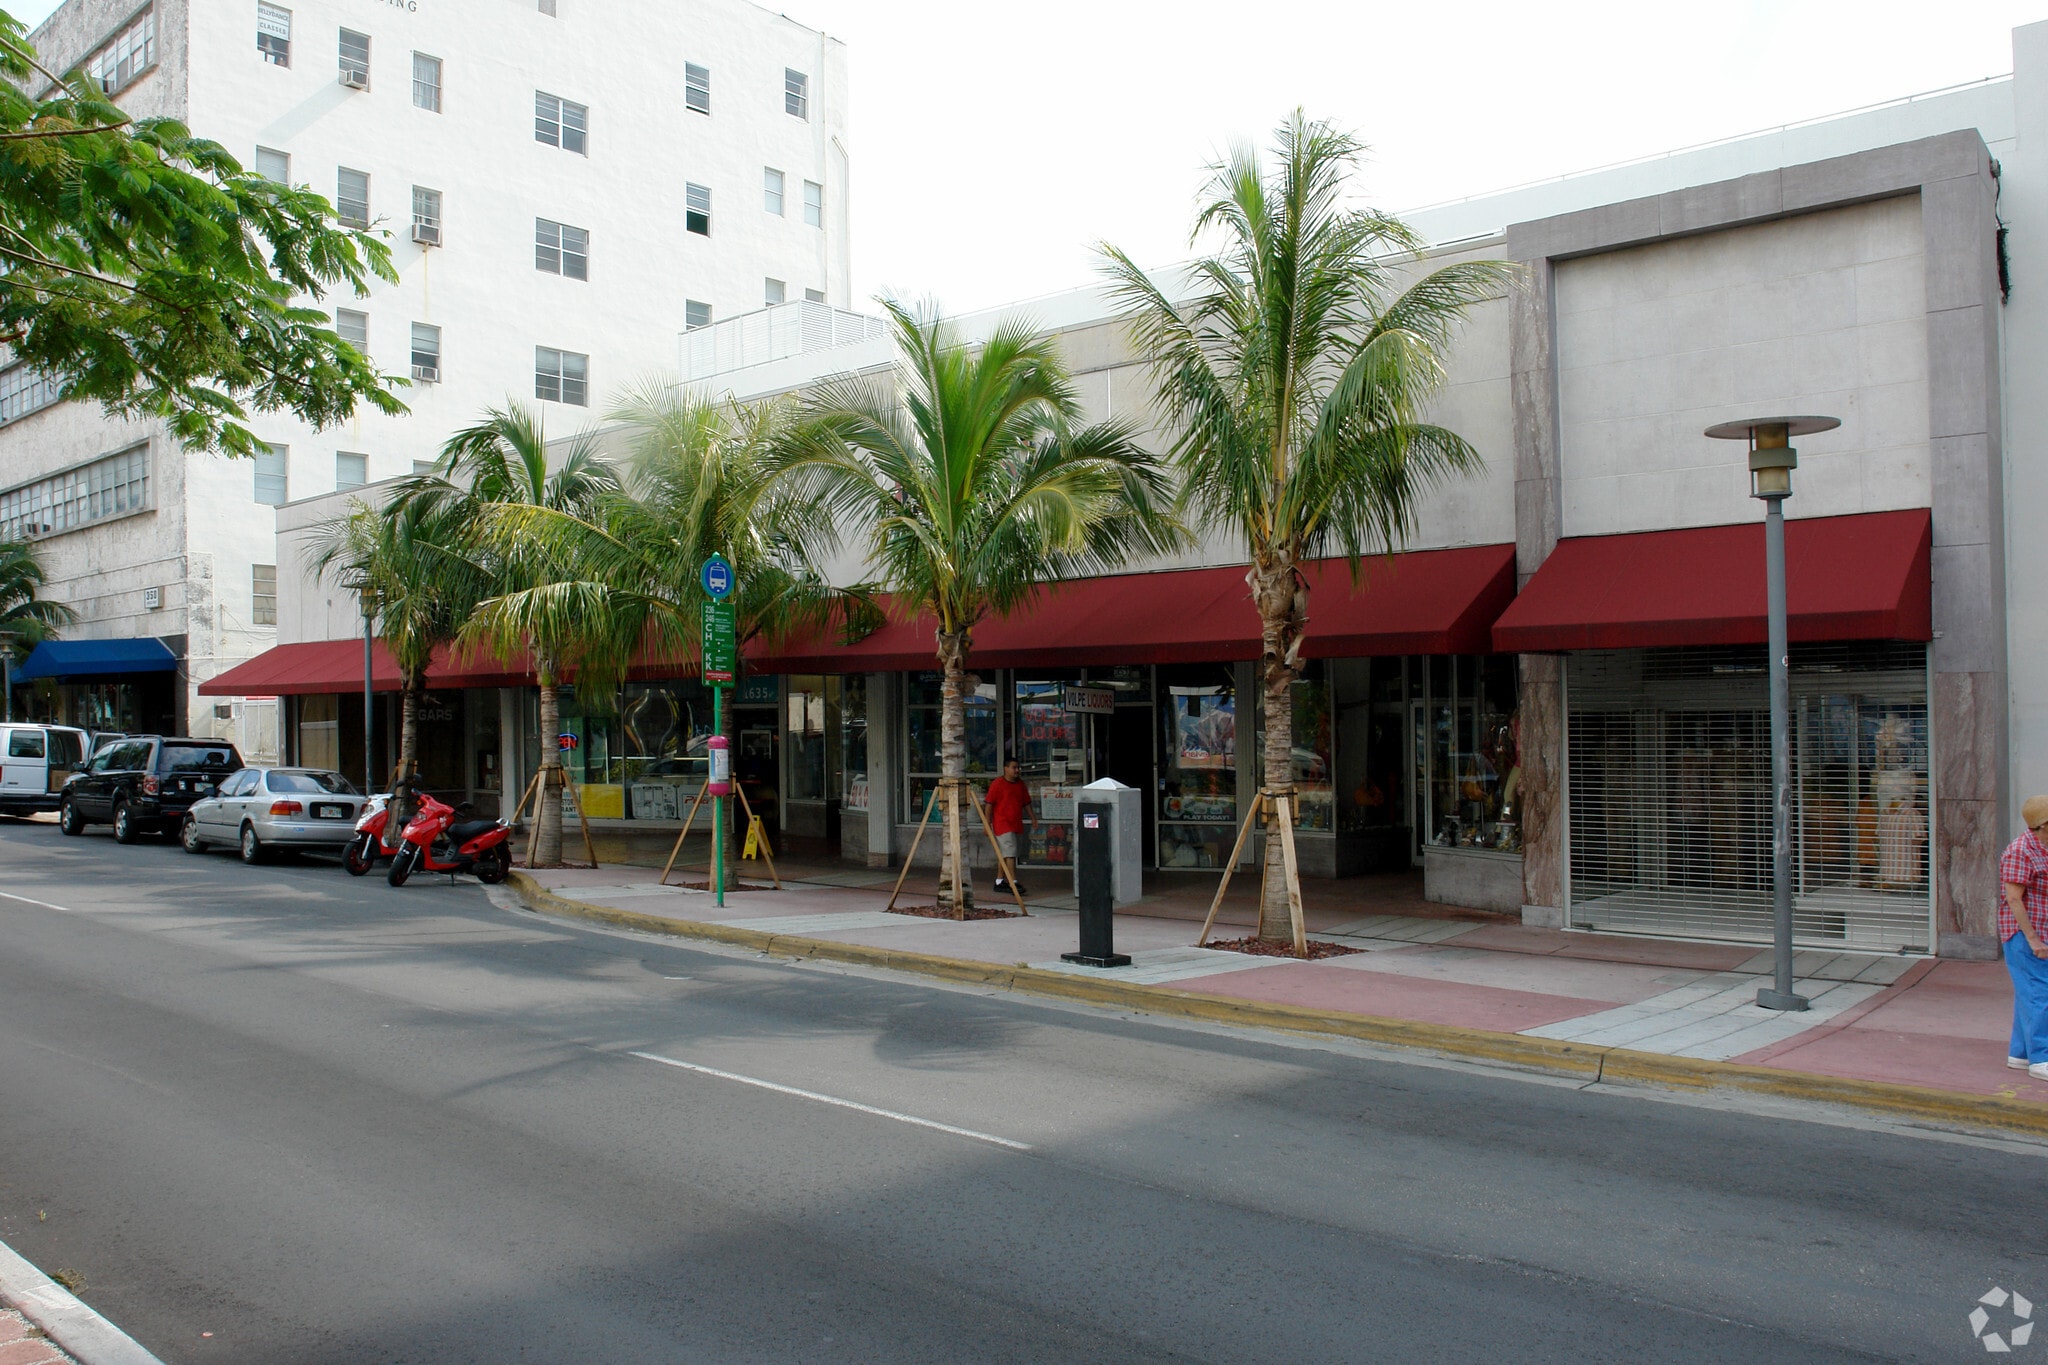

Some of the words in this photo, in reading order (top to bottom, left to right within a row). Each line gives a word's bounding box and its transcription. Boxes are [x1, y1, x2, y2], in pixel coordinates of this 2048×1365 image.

[705, 623, 713, 632] C
[705, 632, 713, 641] H
[705, 652, 712, 661] K
[705, 661, 712, 670] K
[1067, 692, 1086, 707] VOLPE
[1087, 693, 1113, 709] LIQUORS
[418, 709, 453, 721] GARS
[1024, 707, 1073, 723] VOLPE
[1022, 726, 1076, 740] LIQUORS
[559, 737, 577, 749] PEN
